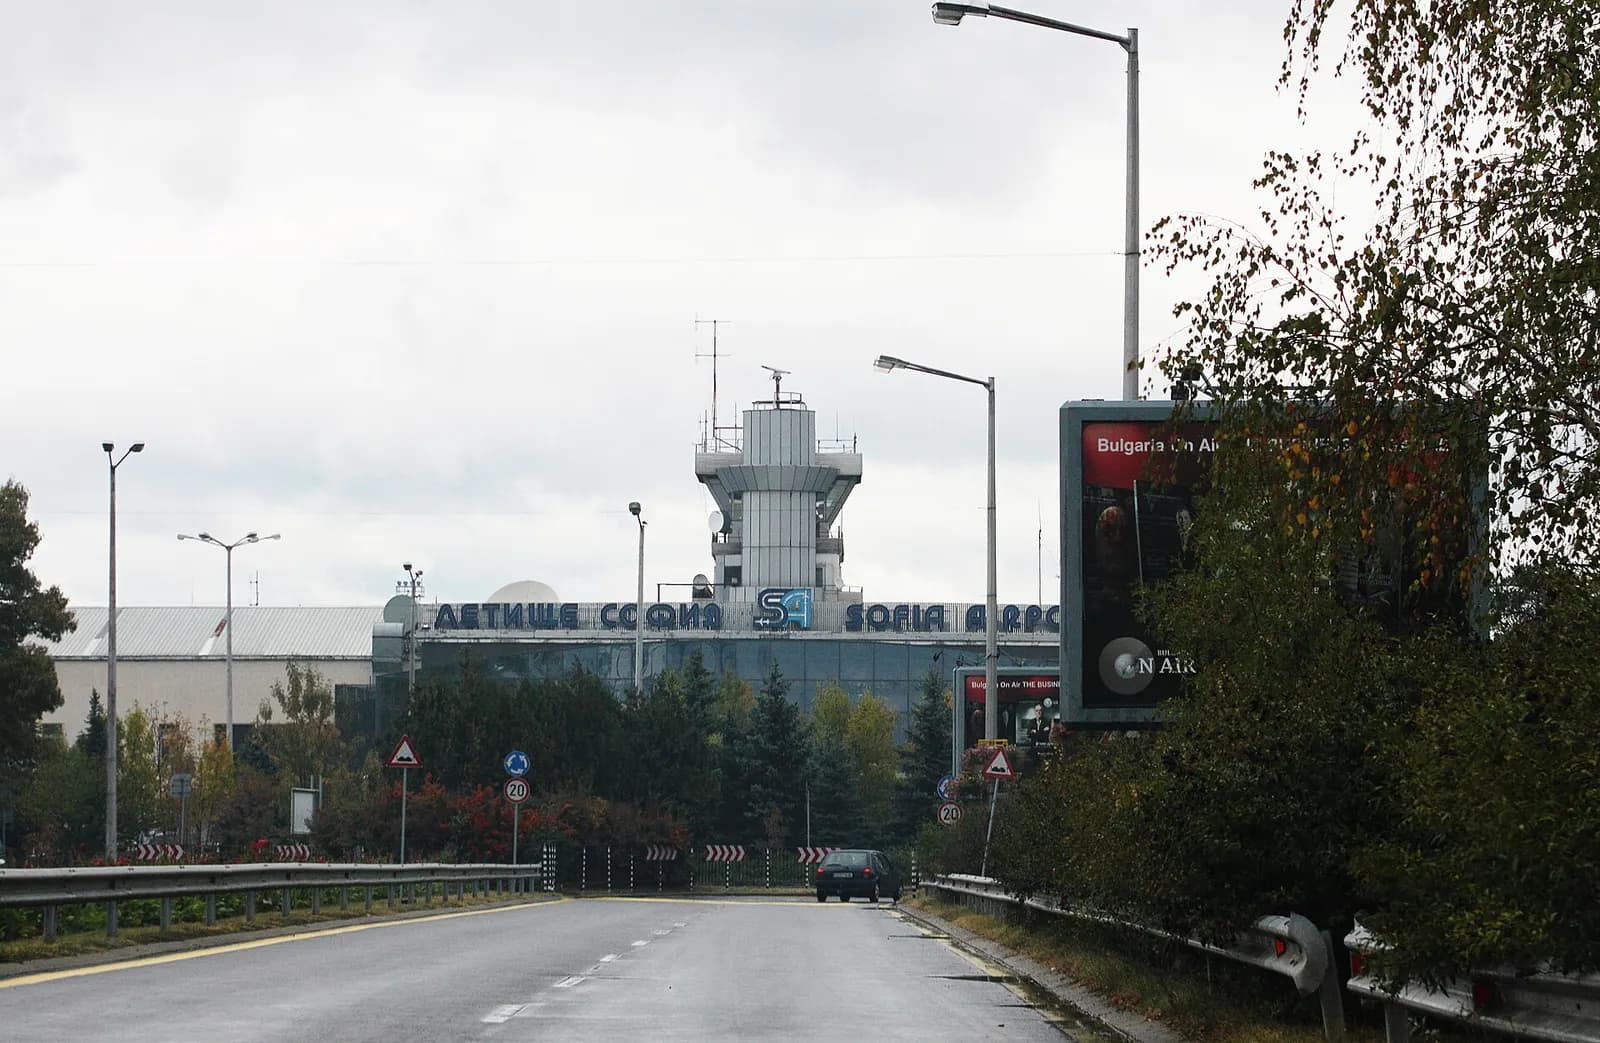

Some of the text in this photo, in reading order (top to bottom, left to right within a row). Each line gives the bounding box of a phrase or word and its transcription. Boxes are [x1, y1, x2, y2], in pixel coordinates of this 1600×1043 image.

[1097, 438, 1164, 455] Bulgaria
[434, 602, 721, 629] ЛЕТИЩЕ СОФИЯ
[846, 604, 1060, 632] SOFIA ARPO
[1000, 681, 1010, 689] On
[1011, 681, 1021, 689] Air
[1022, 681, 1036, 689] THE
[510, 783, 525, 796] 20
[943, 807, 959, 820] 20
